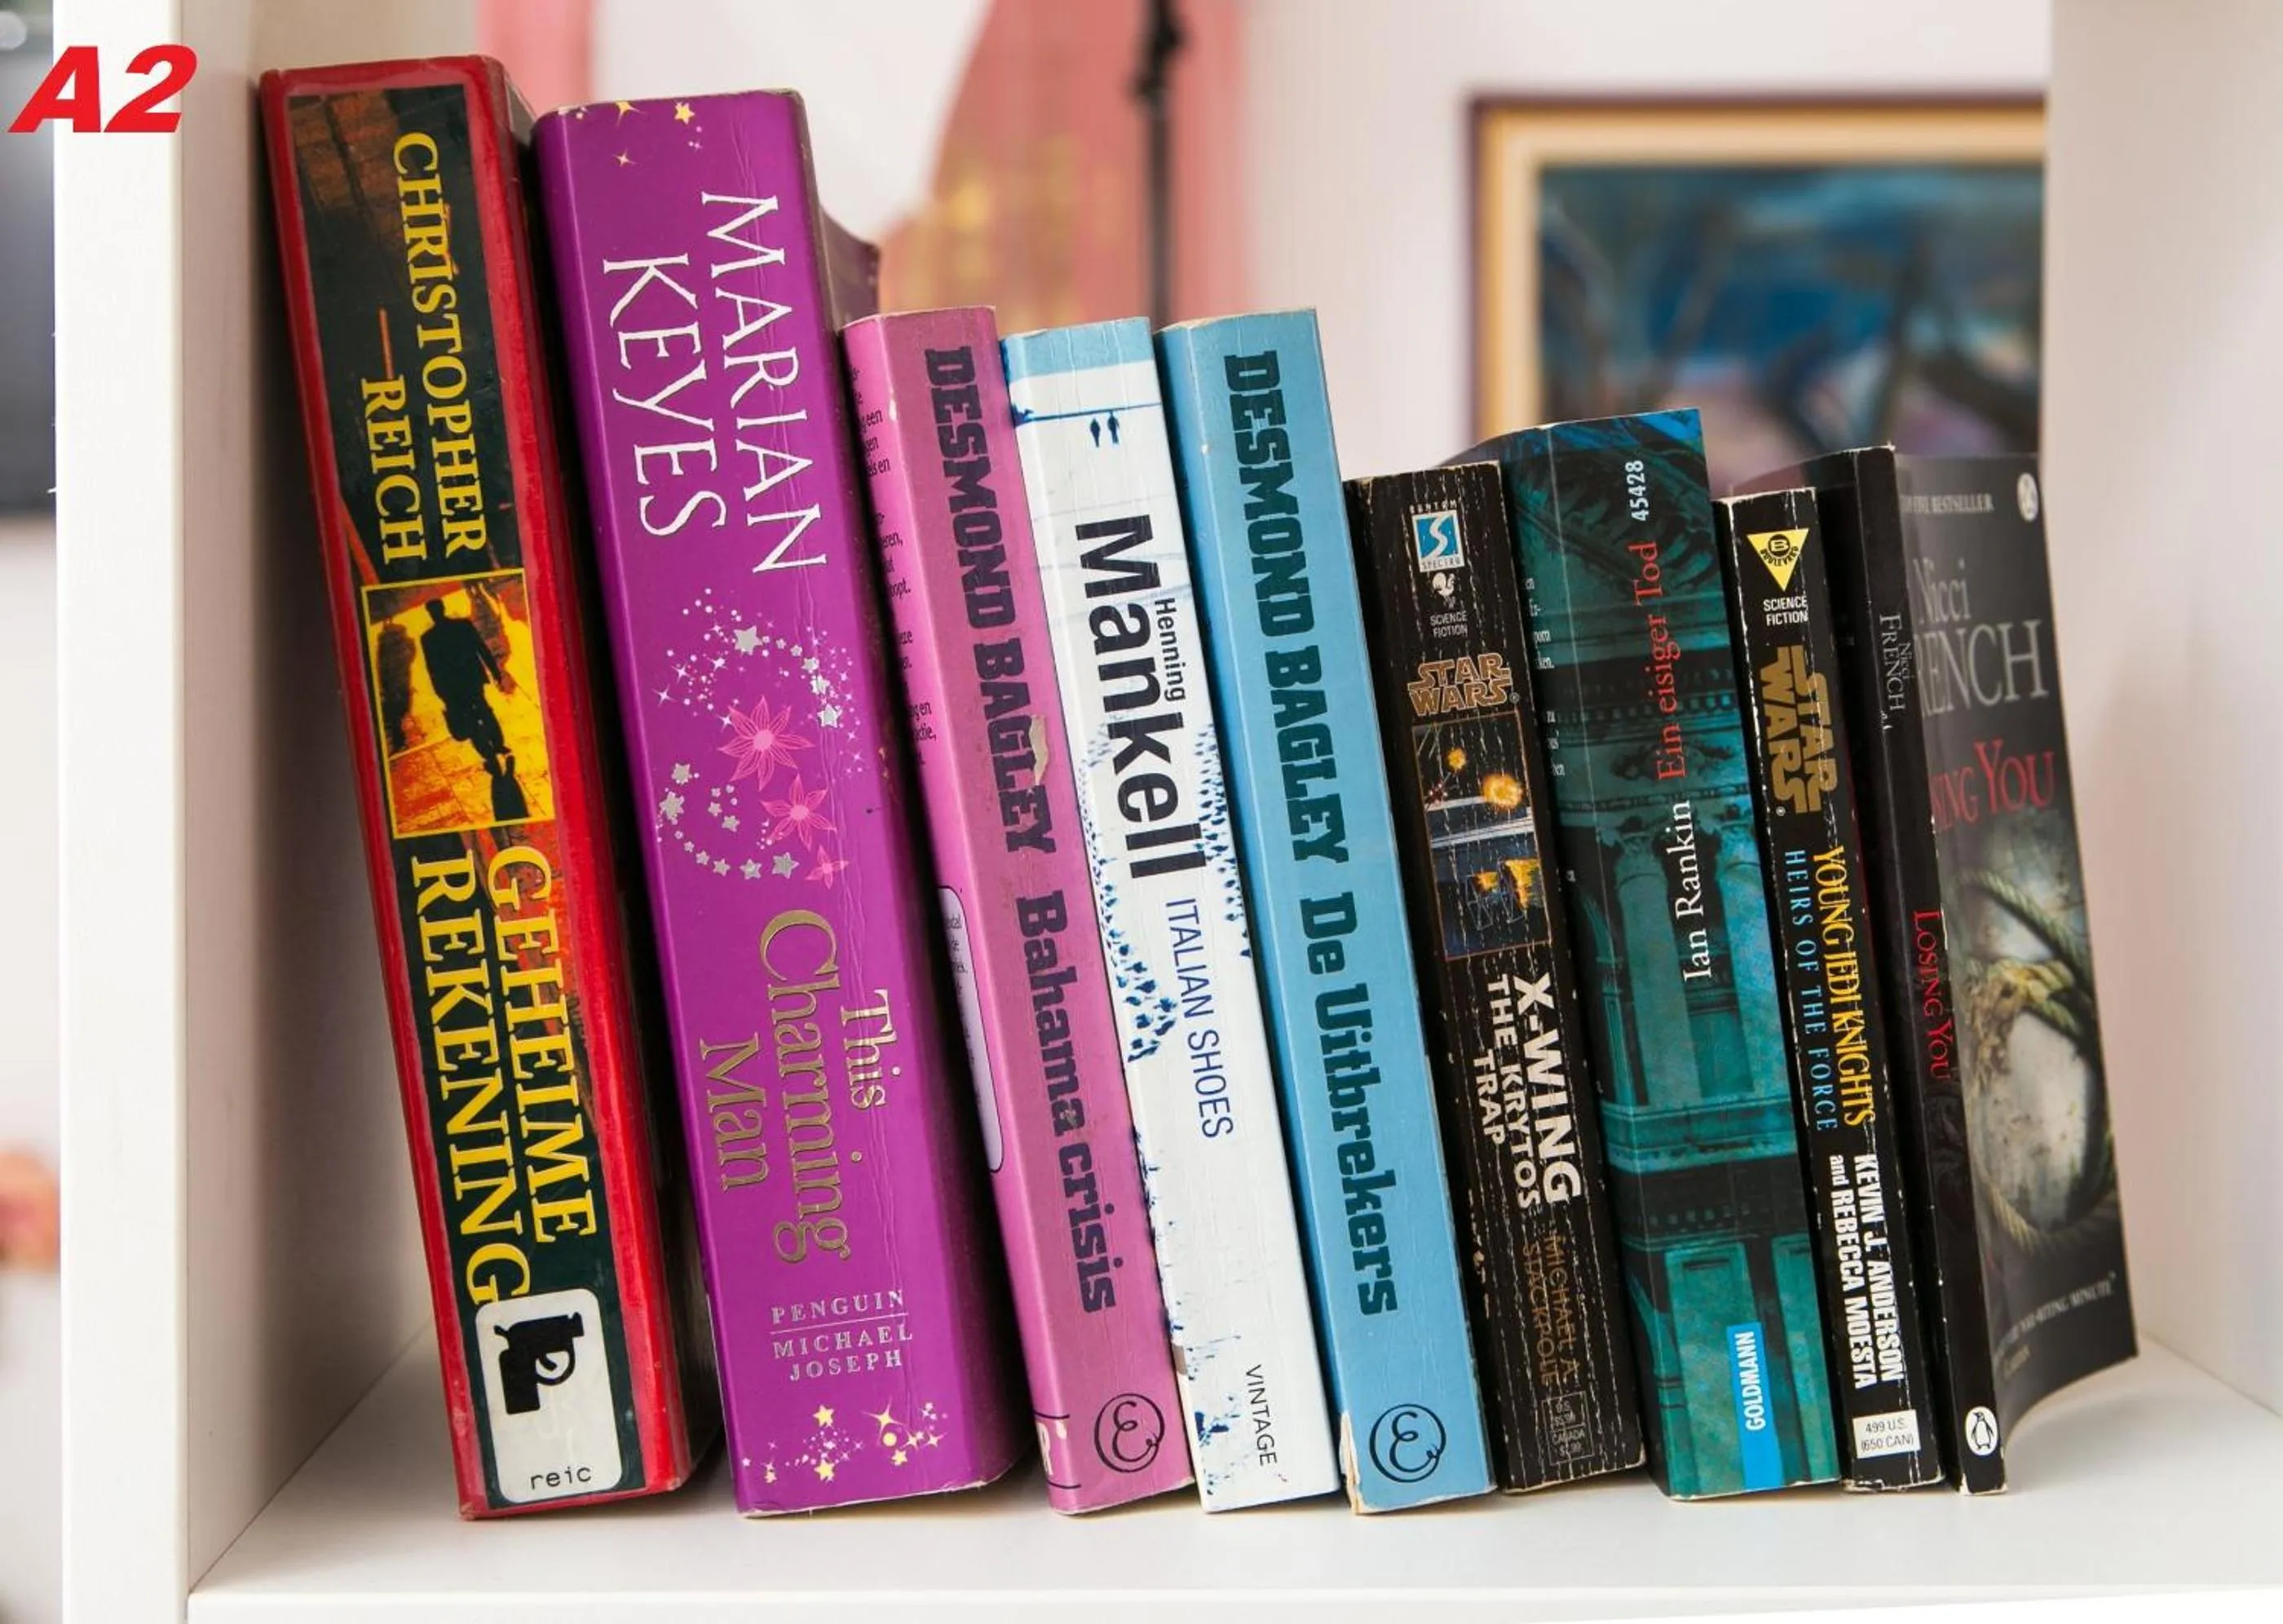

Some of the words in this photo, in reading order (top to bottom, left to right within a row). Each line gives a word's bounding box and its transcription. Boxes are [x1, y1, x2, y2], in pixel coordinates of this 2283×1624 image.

[393, 132, 487, 558] CHRISTOPHER
[603, 254, 727, 536] KEYES
[700, 191, 828, 573] MARIAN
[361, 374, 426, 564] REICH
[1224, 349, 1315, 638] DESMOND
[1624, 459, 1650, 523] 45428
[925, 345, 1018, 631] DESMOND
[974, 637, 1058, 854] BAGLEY
[1430, 611, 1468, 627] SCIENCE
[1627, 540, 1663, 607] Tod
[1763, 596, 1808, 613] SCIENCE
[1766, 611, 1808, 627] FICTION
[1911, 557, 1972, 624] Nicci
[1154, 597, 1187, 702] Henning
[1407, 652, 1512, 691] STAR
[1433, 624, 1468, 638] FICTION
[1645, 614, 1681, 717] eisiger
[1879, 613, 1905, 713] FRENCH
[1898, 641, 1913, 682] Nicci
[1914, 618, 2050, 718] RENCH
[1075, 514, 1207, 879] Mankell
[1407, 680, 1512, 717] WARS
[1760, 645, 1808, 814] WARS
[1791, 645, 1839, 814] STAR
[1264, 645, 1349, 867] BAGLEY
[1657, 723, 1687, 780] Ein
[1665, 800, 1704, 920] Rankin
[1784, 850, 1813, 926] HEIRS
[1813, 845, 1855, 947] YOUNG
[1165, 898, 1215, 1020] ITALIAN
[1299, 891, 1359, 976] De
[1684, 928, 1711, 983] Ian
[1795, 939, 1820, 972] OF
[1824, 951, 1862, 1005] JEDI
[488, 845, 598, 1243] GEHEIME
[840, 988, 903, 1110] This
[1487, 973, 1519, 1050] THE
[1800, 987, 1827, 1035] THE
[411, 856, 532, 1306] REKENING
[700, 1032, 770, 1192] Man
[759, 909, 864, 1263] Charming
[1016, 889, 1085, 1137] Bahama
[1058, 1143, 1124, 1314] crisis
[1186, 1029, 1234, 1139] SHOES
[1473, 1048, 1507, 1146] TRAP
[1512, 972, 1582, 1204] X-WING
[1808, 1048, 1838, 1132] FORCE
[1831, 1008, 1876, 1128] KNIGHTS
[1314, 982, 1398, 1318] Uitbrekers
[1499, 1063, 1541, 1210] KRYTOS
[1830, 1154, 1849, 1186] and
[1830, 1189, 1865, 1292] REBECCA
[1853, 1154, 1887, 1233] KEVIN
[771, 1289, 906, 1326] PENGUIN
[773, 1323, 912, 1359] MICHAEL
[1521, 1242, 1560, 1387] STACKPOLE
[1543, 1231, 1577, 1349] MICHAEL
[1866, 1260, 1905, 1382] ANDERSON
[788, 1348, 903, 1382] JOSEPH
[1734, 1331, 1765, 1432] GOLDMANN
[1844, 1296, 1877, 1390] MOESTA
[1245, 1363, 1279, 1467] VINTAGE
[528, 1464, 592, 1490] reic
